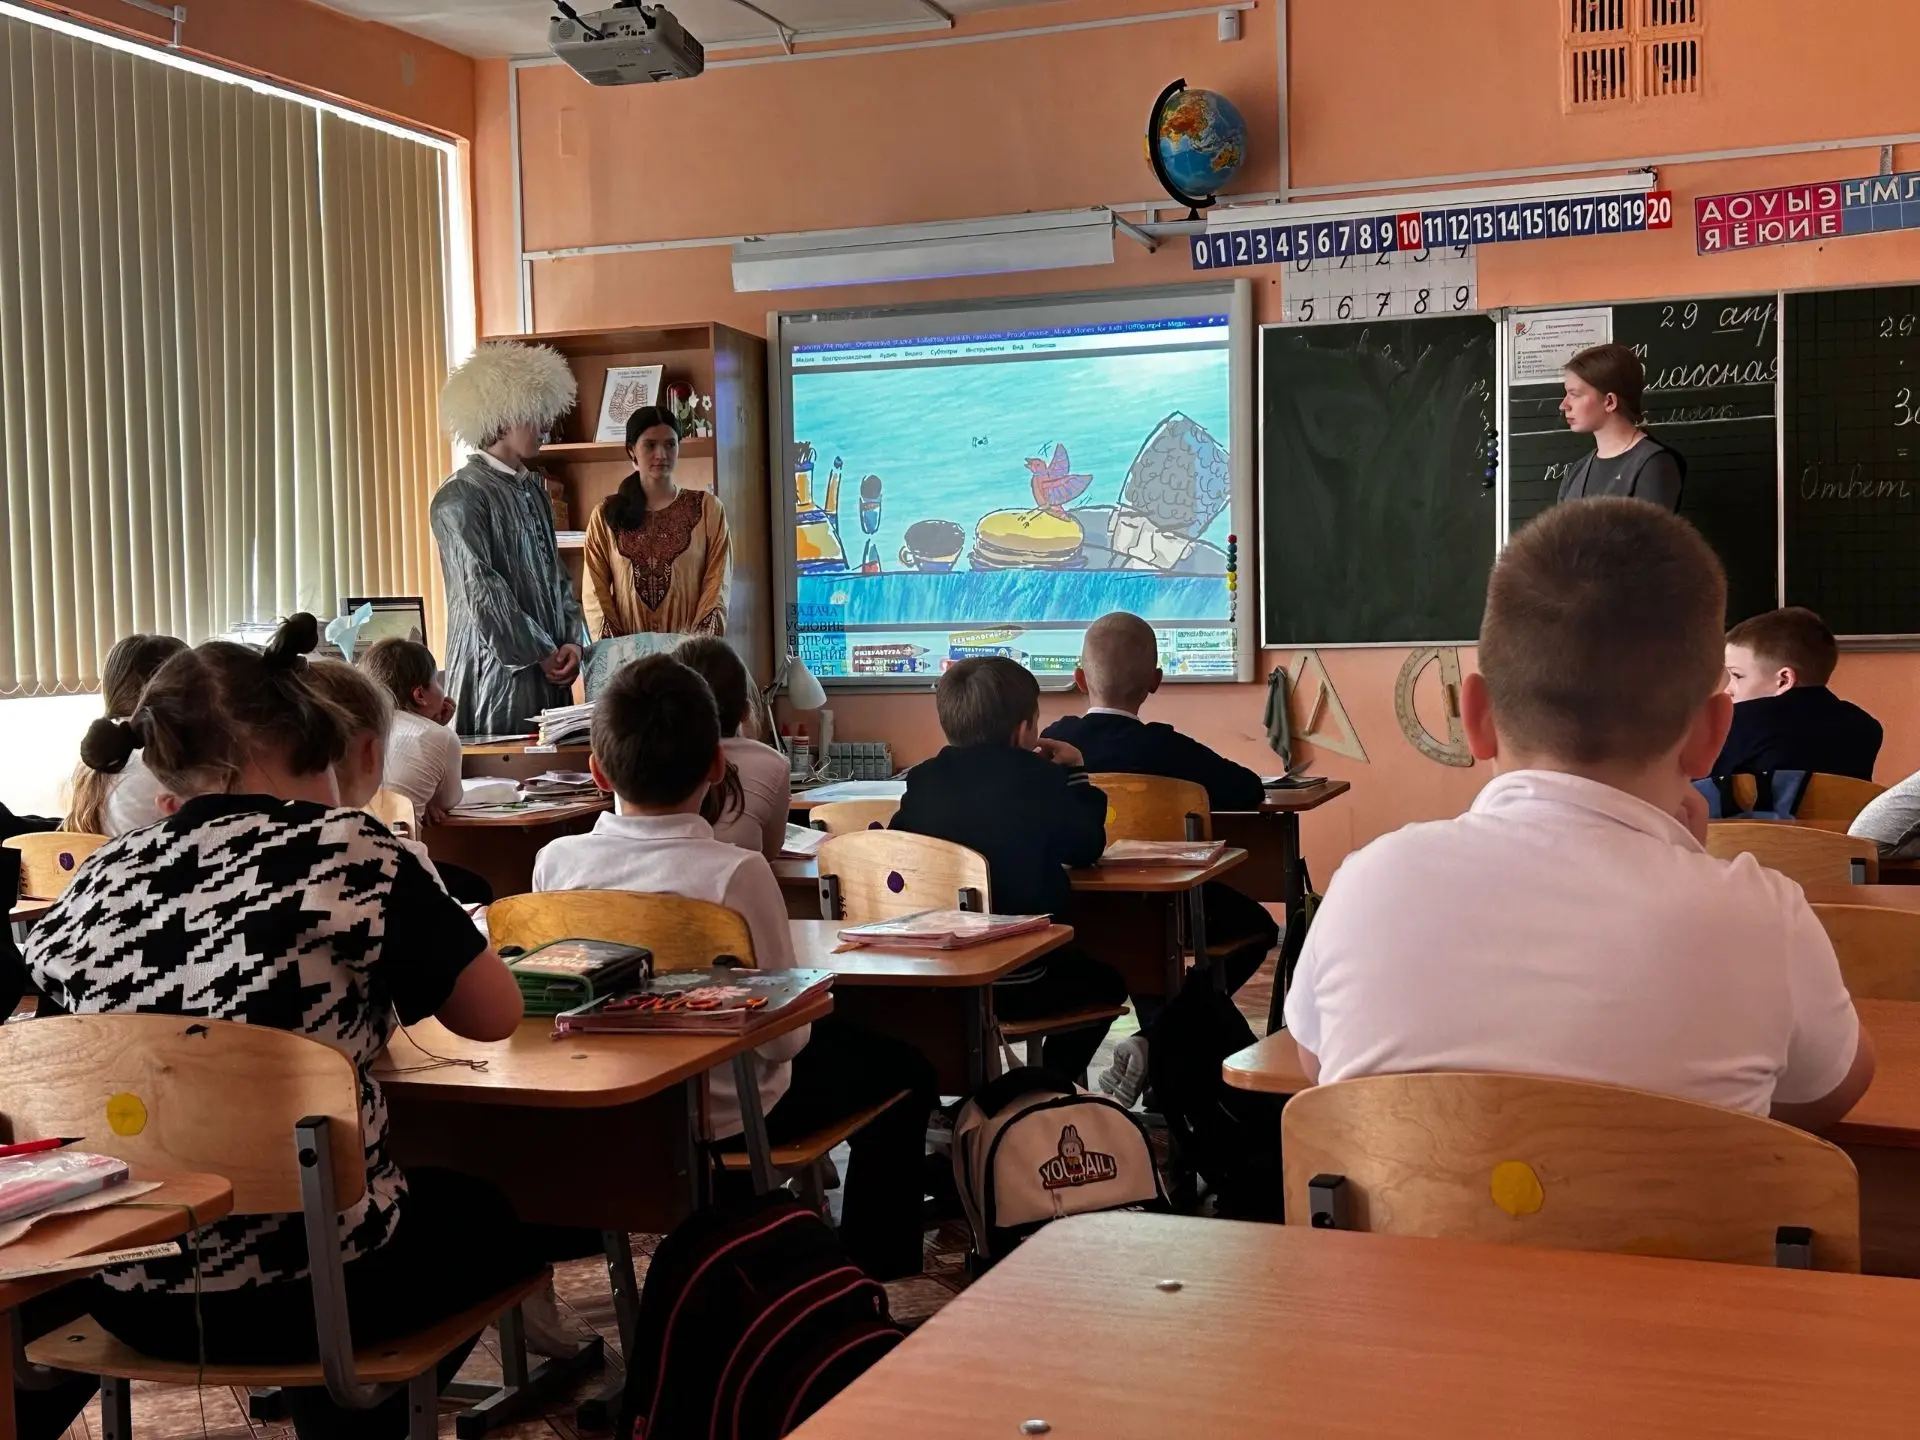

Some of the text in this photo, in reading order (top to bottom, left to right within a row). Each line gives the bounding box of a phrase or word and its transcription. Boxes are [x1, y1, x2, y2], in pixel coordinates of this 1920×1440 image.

[1195, 240, 1208, 264] 0
[1215, 238, 1226, 263] 1
[1236, 236, 1248, 261] 2
[1256, 234, 1268, 259] 3
[1276, 232, 1289, 257] 4
[1298, 230, 1309, 255] 5
[1317, 228, 1330, 253] 6
[1338, 226, 1350, 251] 7
[1359, 224, 1372, 249] 8
[1380, 222, 1393, 247] 9
[1400, 219, 1420, 245] 10
[1424, 217, 1443, 242] 11
[1448, 214, 1469, 240] 12
[1472, 212, 1494, 238] 13
[1497, 210, 1519, 236] 14
[1522, 208, 1543, 234] 15
[1547, 205, 1569, 232] 16
[1572, 203, 1594, 230] 17
[1597, 201, 1620, 228] 18
[1622, 199, 1645, 226] 19
[1647, 197, 1671, 224] 20
[1298, 285, 1469, 321] 5 6 7 8 9
[1660, 302, 1777, 347] 29 апр
[1640, 356, 1777, 392] лассна
[791, 604, 839, 617] ЗАДАЧА
[788, 635, 840, 646] ВОПРОС
